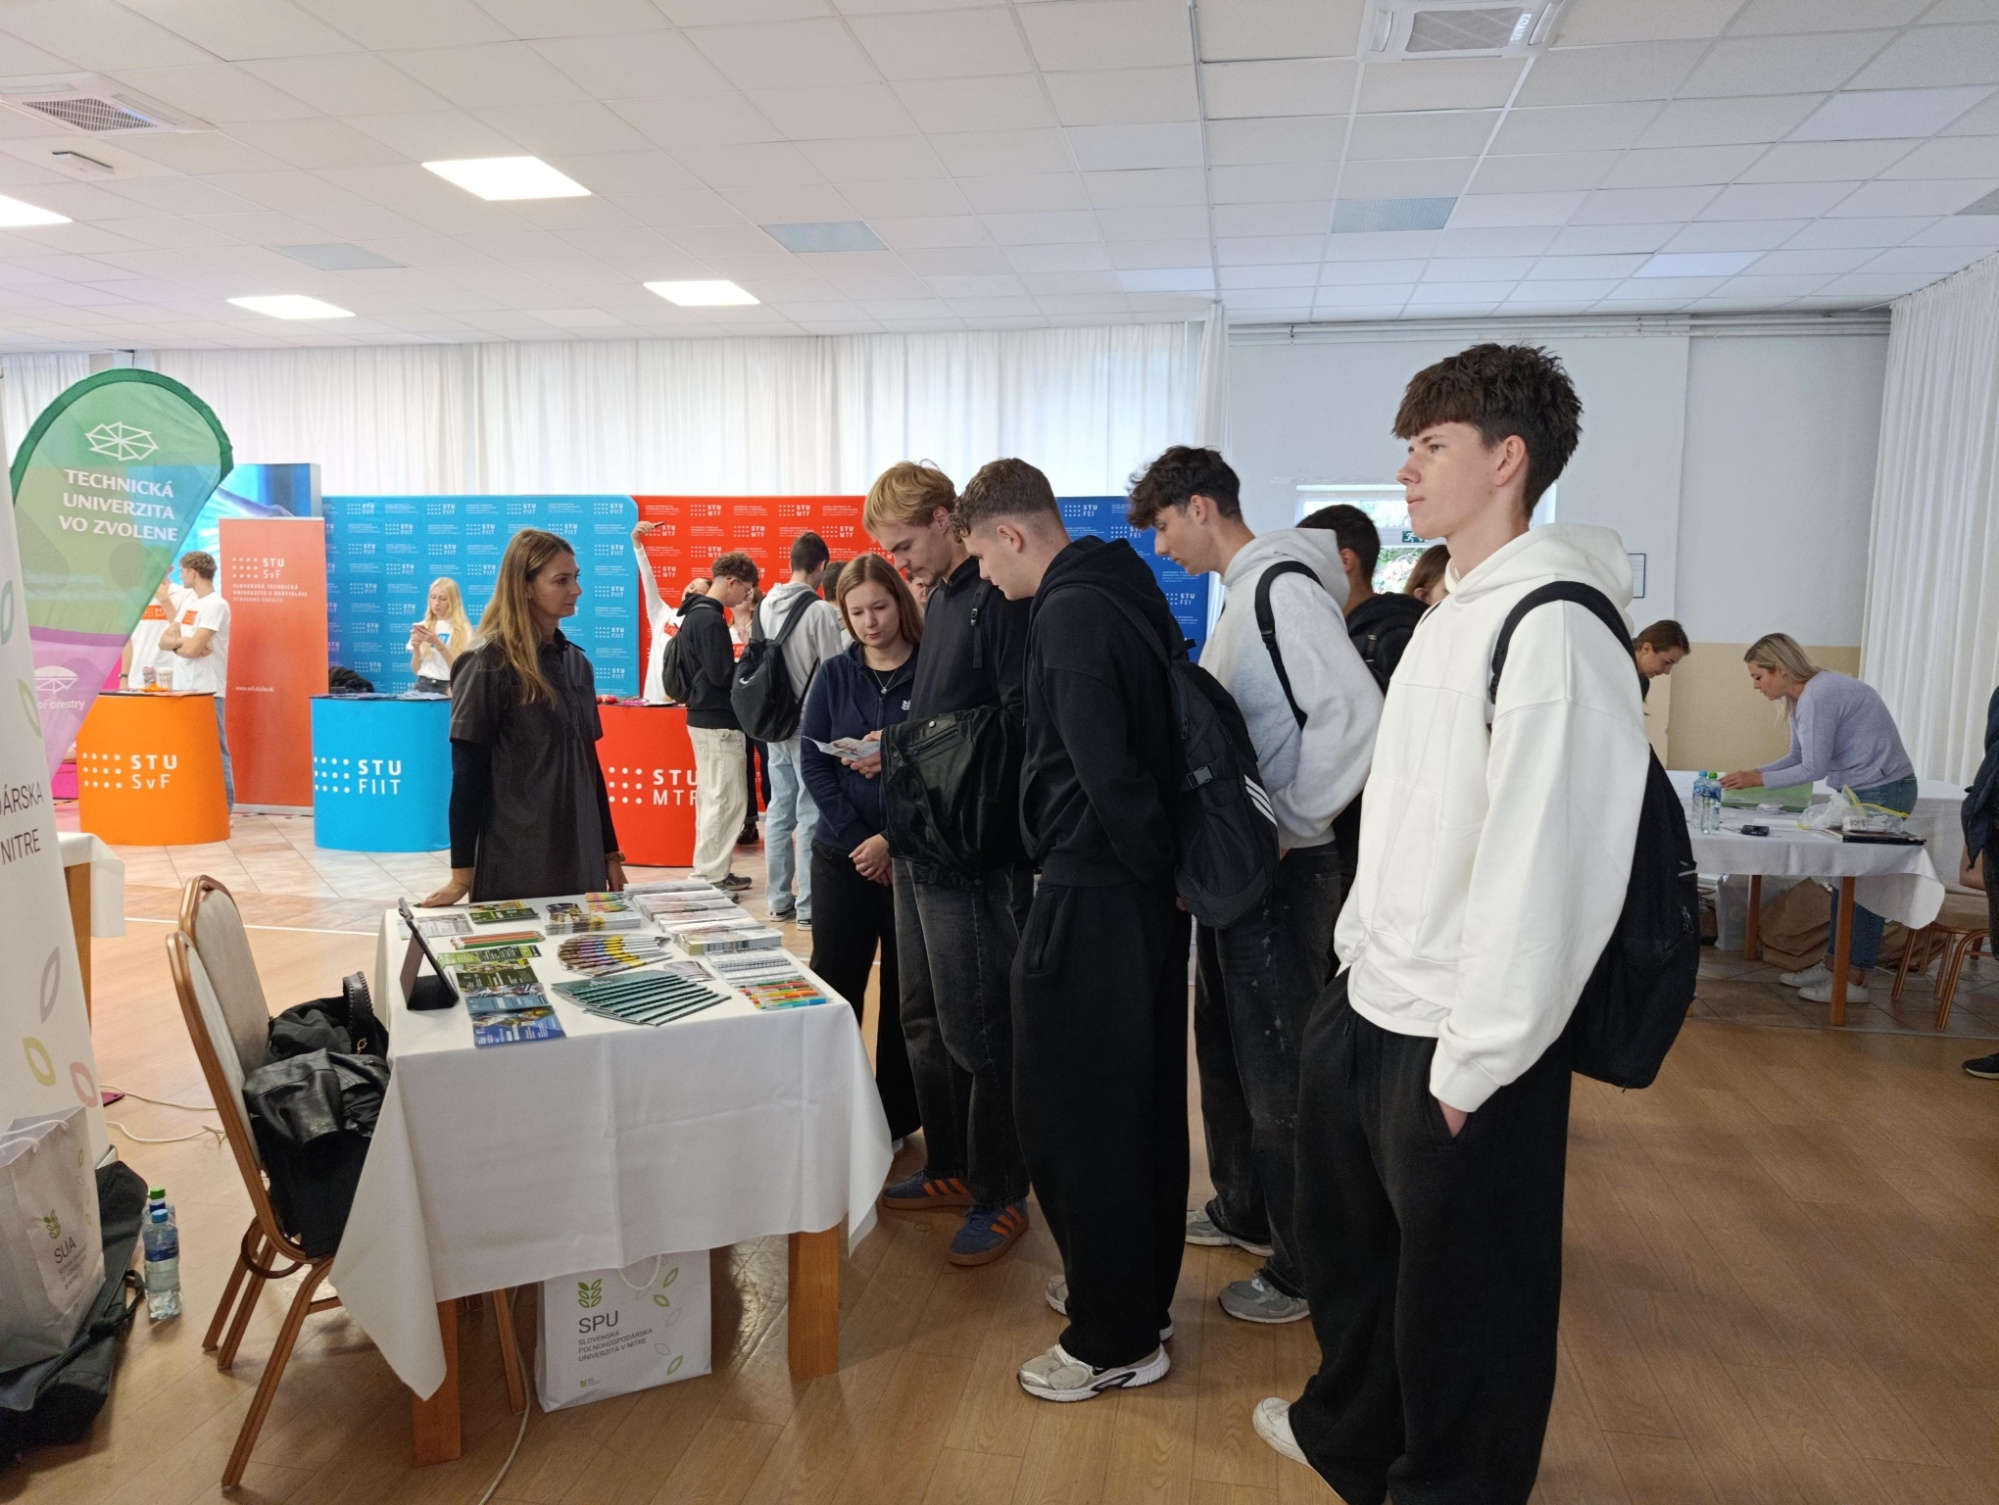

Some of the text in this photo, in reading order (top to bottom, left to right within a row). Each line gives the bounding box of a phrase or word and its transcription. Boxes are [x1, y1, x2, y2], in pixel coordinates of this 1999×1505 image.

[64, 469, 174, 498] TECHNICKÁ
[63, 493, 175, 520] UNIVERZITA
[59, 515, 178, 541] VO ZVOLENE
[263, 558, 284, 567] STU
[263, 570, 281, 578] SvF
[130, 754, 177, 770] STU
[358, 759, 402, 776] STU
[131, 773, 171, 790] SvF
[652, 769, 697, 786] STU
[359, 778, 401, 795] FIIT
[0, 828, 41, 866] NITRE
[54, 1236, 76, 1264] SUA
[578, 1310, 619, 1334] SPU
[578, 1330, 620, 1345] SLOVENSKÁ
[578, 1346, 620, 1361] UNIVERZITA
[627, 1338, 647, 1348] NITRE
